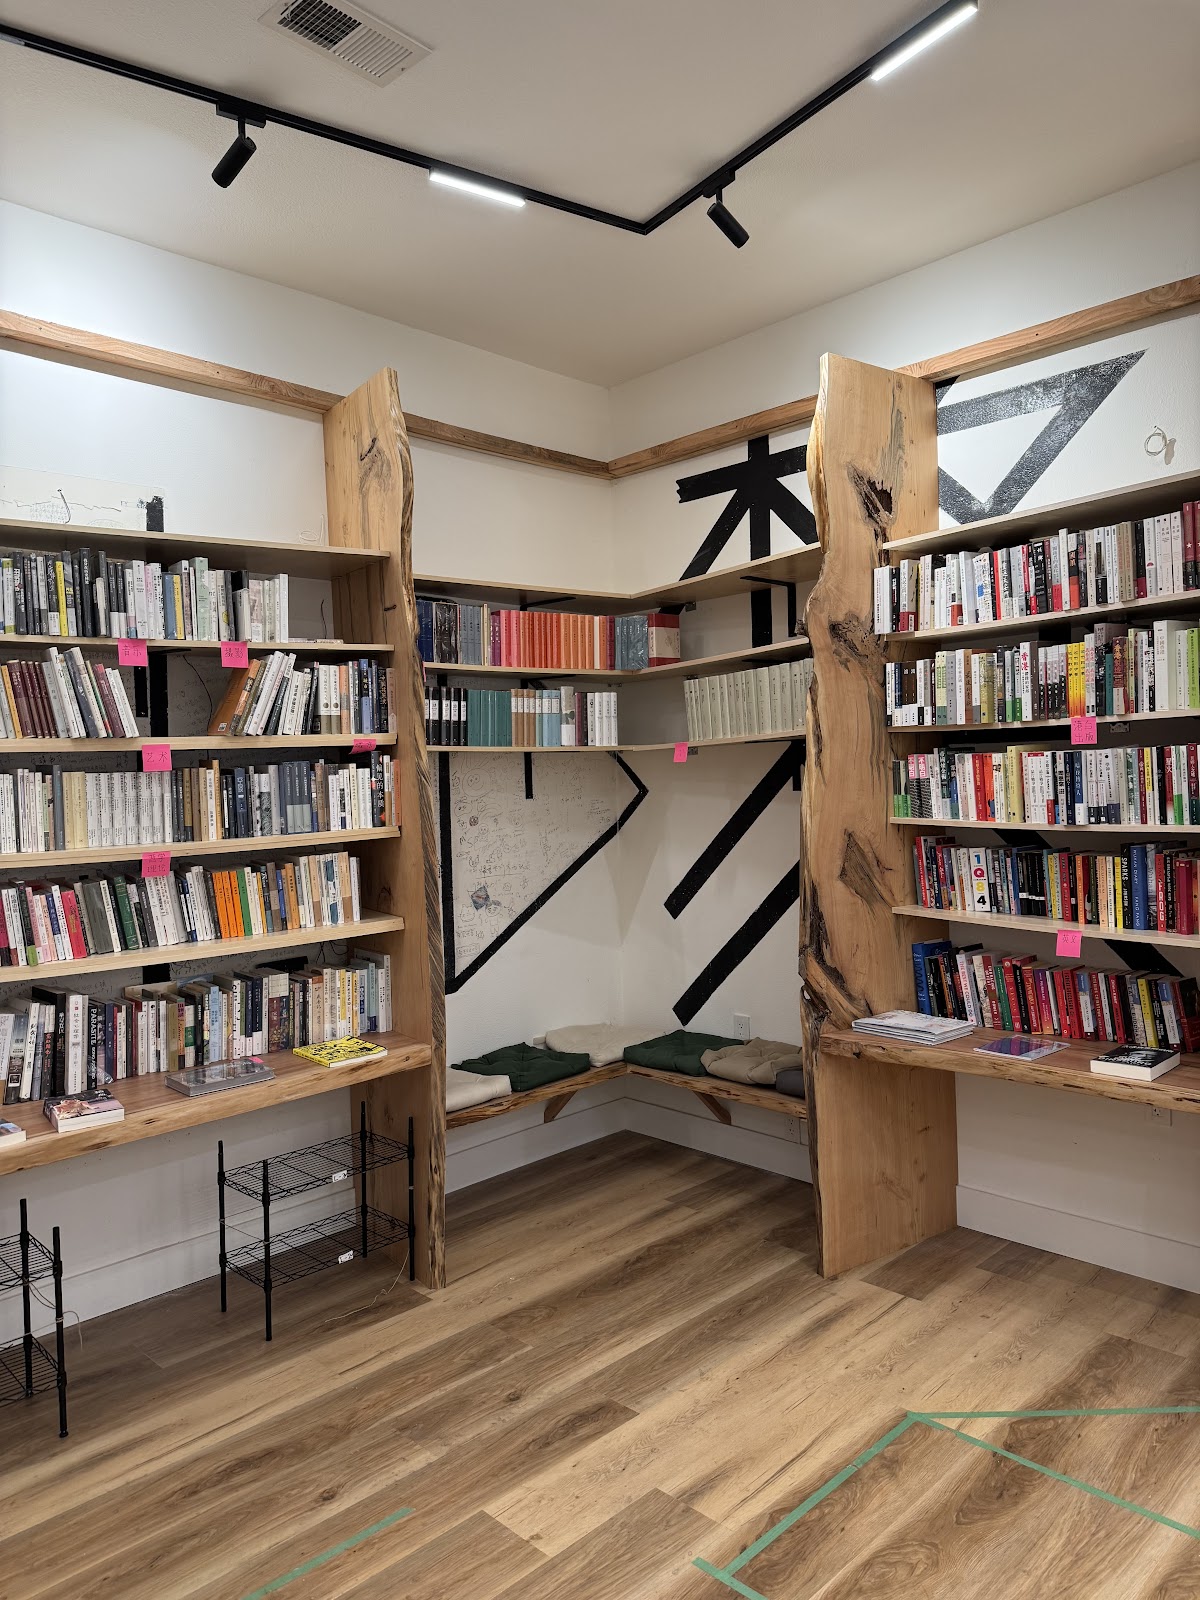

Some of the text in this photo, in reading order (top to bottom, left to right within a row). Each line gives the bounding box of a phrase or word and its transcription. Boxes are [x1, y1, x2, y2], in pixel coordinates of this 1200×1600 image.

[122, 645, 142, 657] 音乐
[1020, 652, 1029, 671] 香港
[1074, 732, 1095, 743] 出版
[146, 751, 168, 763] 艺术
[1121, 857, 1129, 880] SPARKS
[973, 854, 987, 906] 1Q84
[1157, 878, 1165, 920] FROG
[1061, 935, 1078, 944] 英文
[964, 990, 972, 1008] COULD
[90, 1008, 98, 1046] PARASITE
